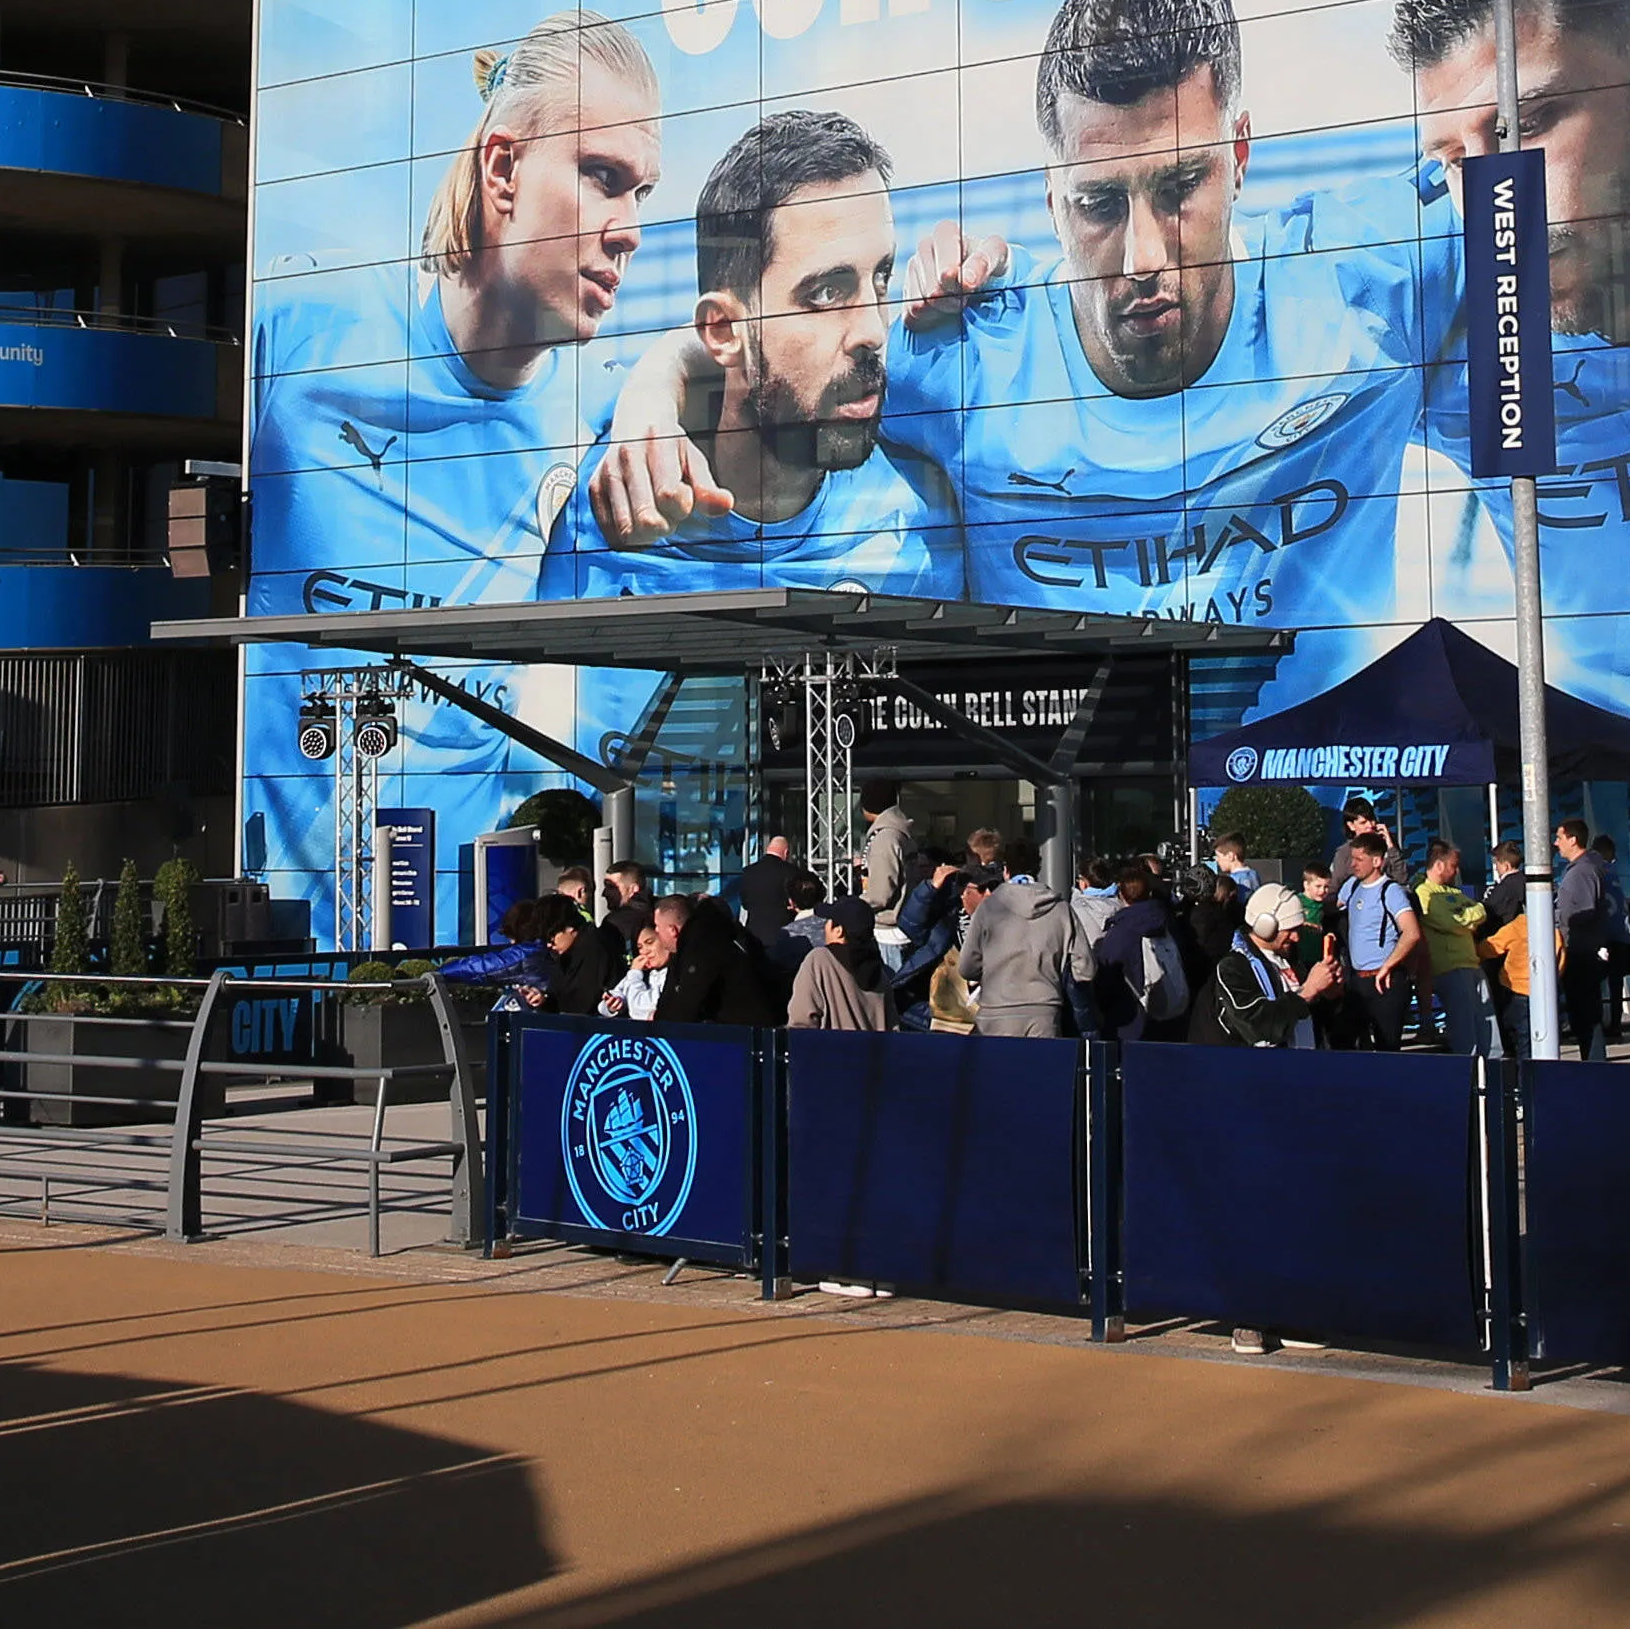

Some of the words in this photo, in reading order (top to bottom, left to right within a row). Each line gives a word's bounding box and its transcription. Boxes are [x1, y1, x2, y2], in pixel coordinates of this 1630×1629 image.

[1493, 177, 1516, 266] WEST
[1496, 275, 1523, 449] RECEPTION
[1012, 477, 1350, 590] ETIHAD
[965, 691, 1017, 727] BELL
[1260, 745, 1399, 780] MANCHESTER
[1400, 744, 1450, 777] CITY
[232, 998, 300, 1054] CITY
[573, 1039, 673, 1121] MANCHESTER
[622, 1202, 659, 1230] CITY
